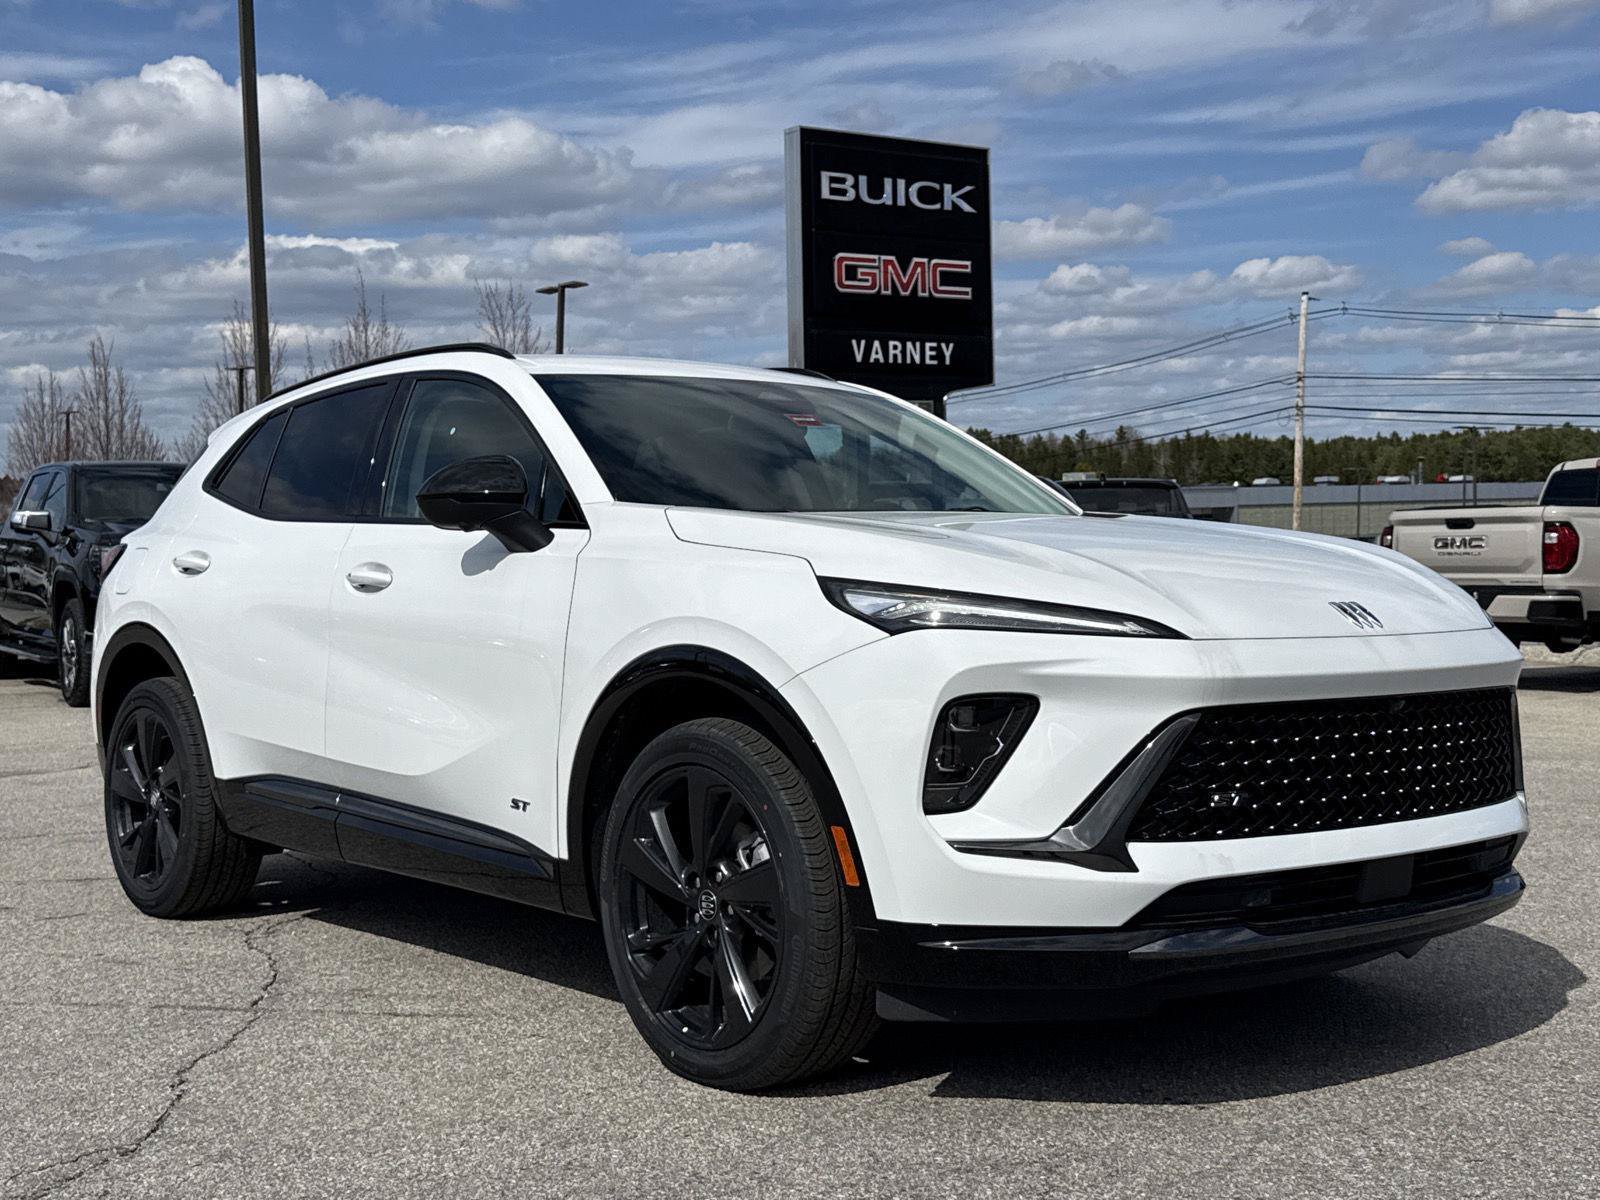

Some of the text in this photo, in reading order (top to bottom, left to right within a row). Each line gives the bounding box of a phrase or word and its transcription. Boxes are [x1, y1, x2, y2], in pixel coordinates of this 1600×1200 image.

[820, 170, 977, 213] BUICK
[834, 252, 972, 299] GMC
[851, 338, 954, 366] VARNEY
[1433, 536, 1486, 550] GMC
[510, 798, 531, 812] ST
